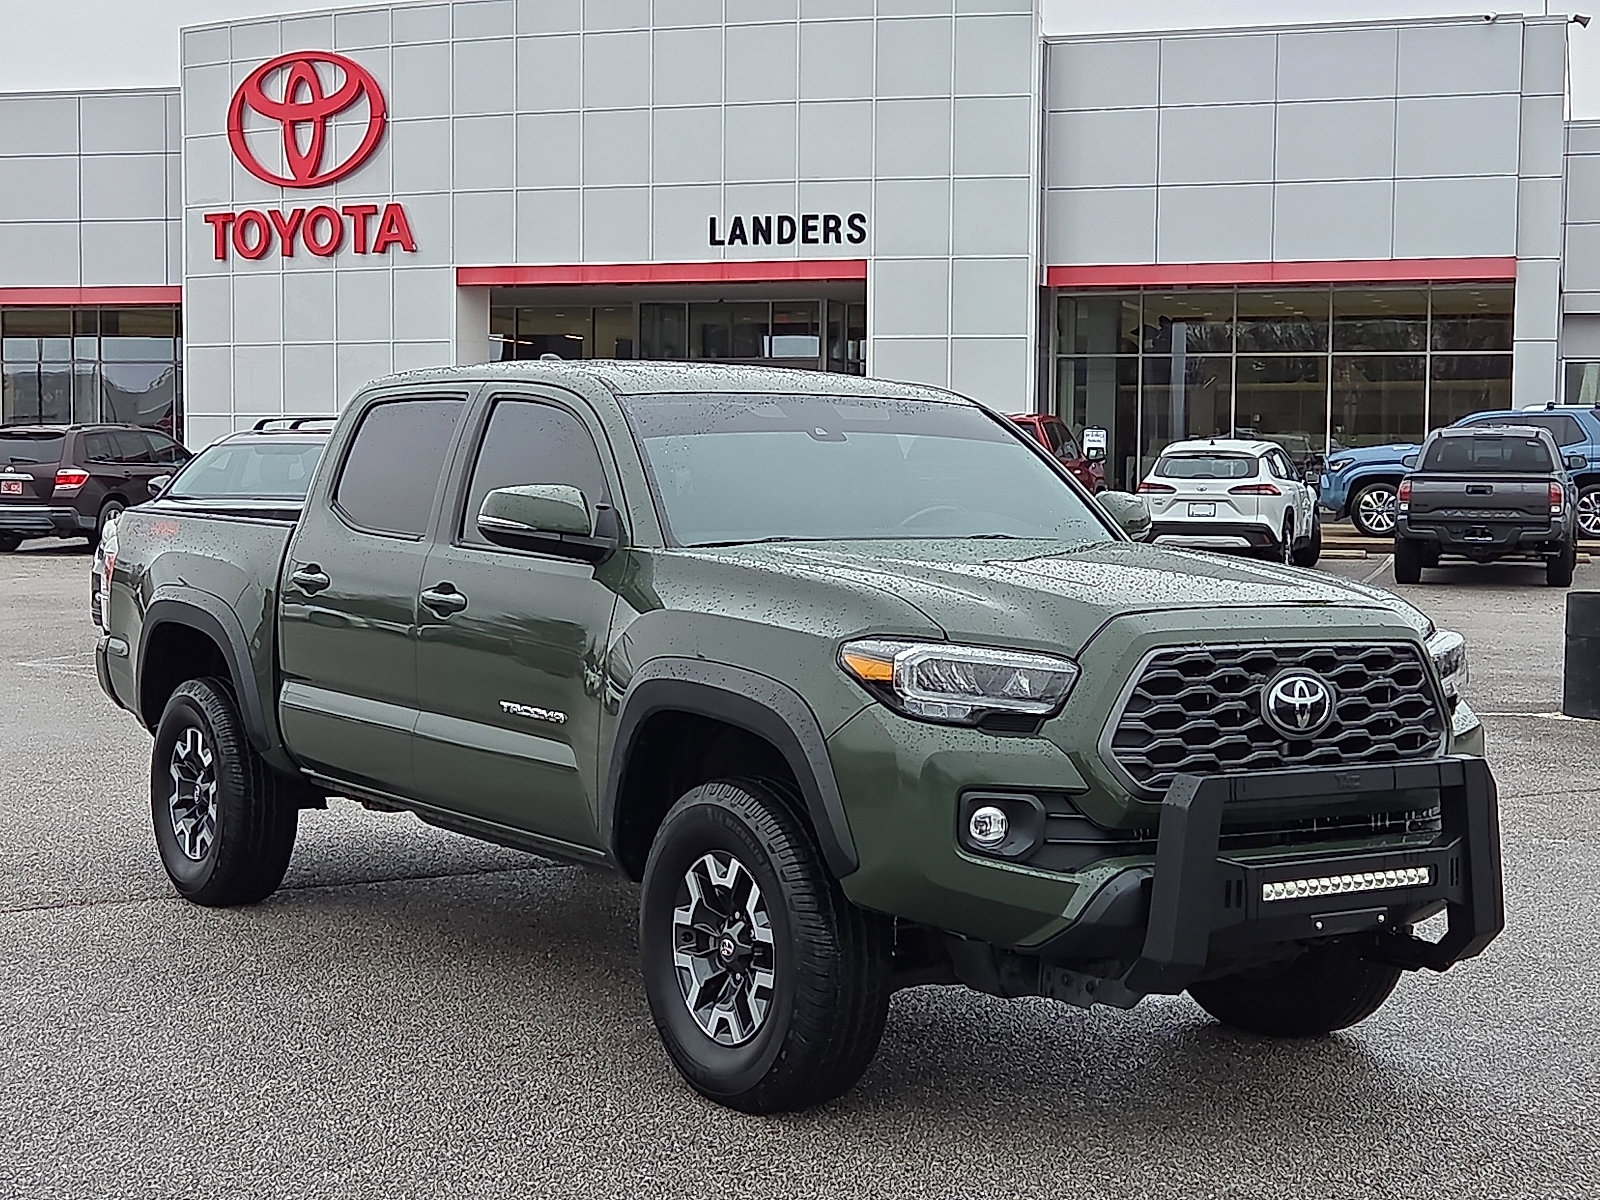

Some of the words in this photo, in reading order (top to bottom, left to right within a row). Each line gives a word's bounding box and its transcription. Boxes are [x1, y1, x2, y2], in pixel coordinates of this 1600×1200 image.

[204, 203, 416, 260] TOYOTA
[709, 213, 867, 246] LANDERS
[499, 700, 568, 724] TACOMA
